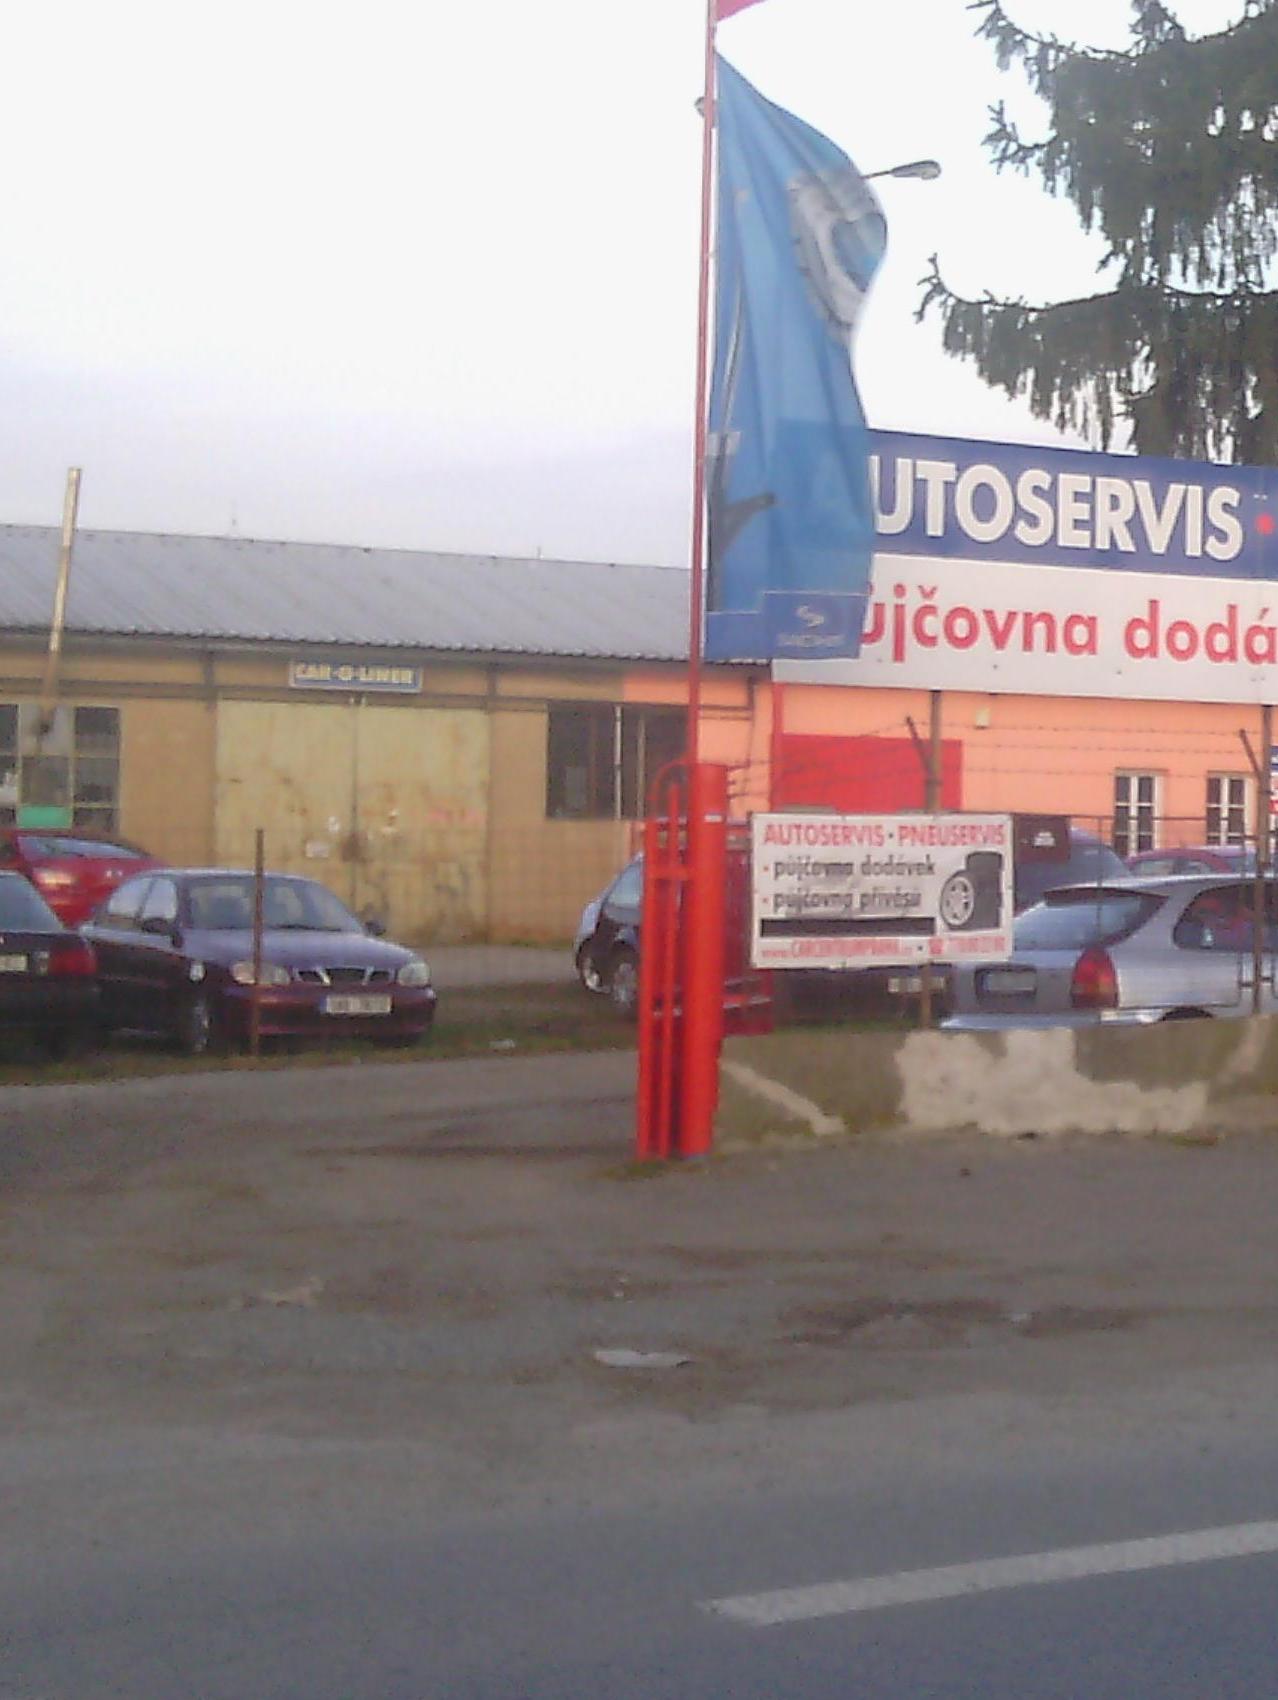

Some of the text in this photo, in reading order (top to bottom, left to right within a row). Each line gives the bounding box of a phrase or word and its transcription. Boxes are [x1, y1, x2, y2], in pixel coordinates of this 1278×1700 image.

[764, 823, 1005, 847] AUTOSERVIS PNEUSERVIS
[861, 854, 935, 876] dodávek
